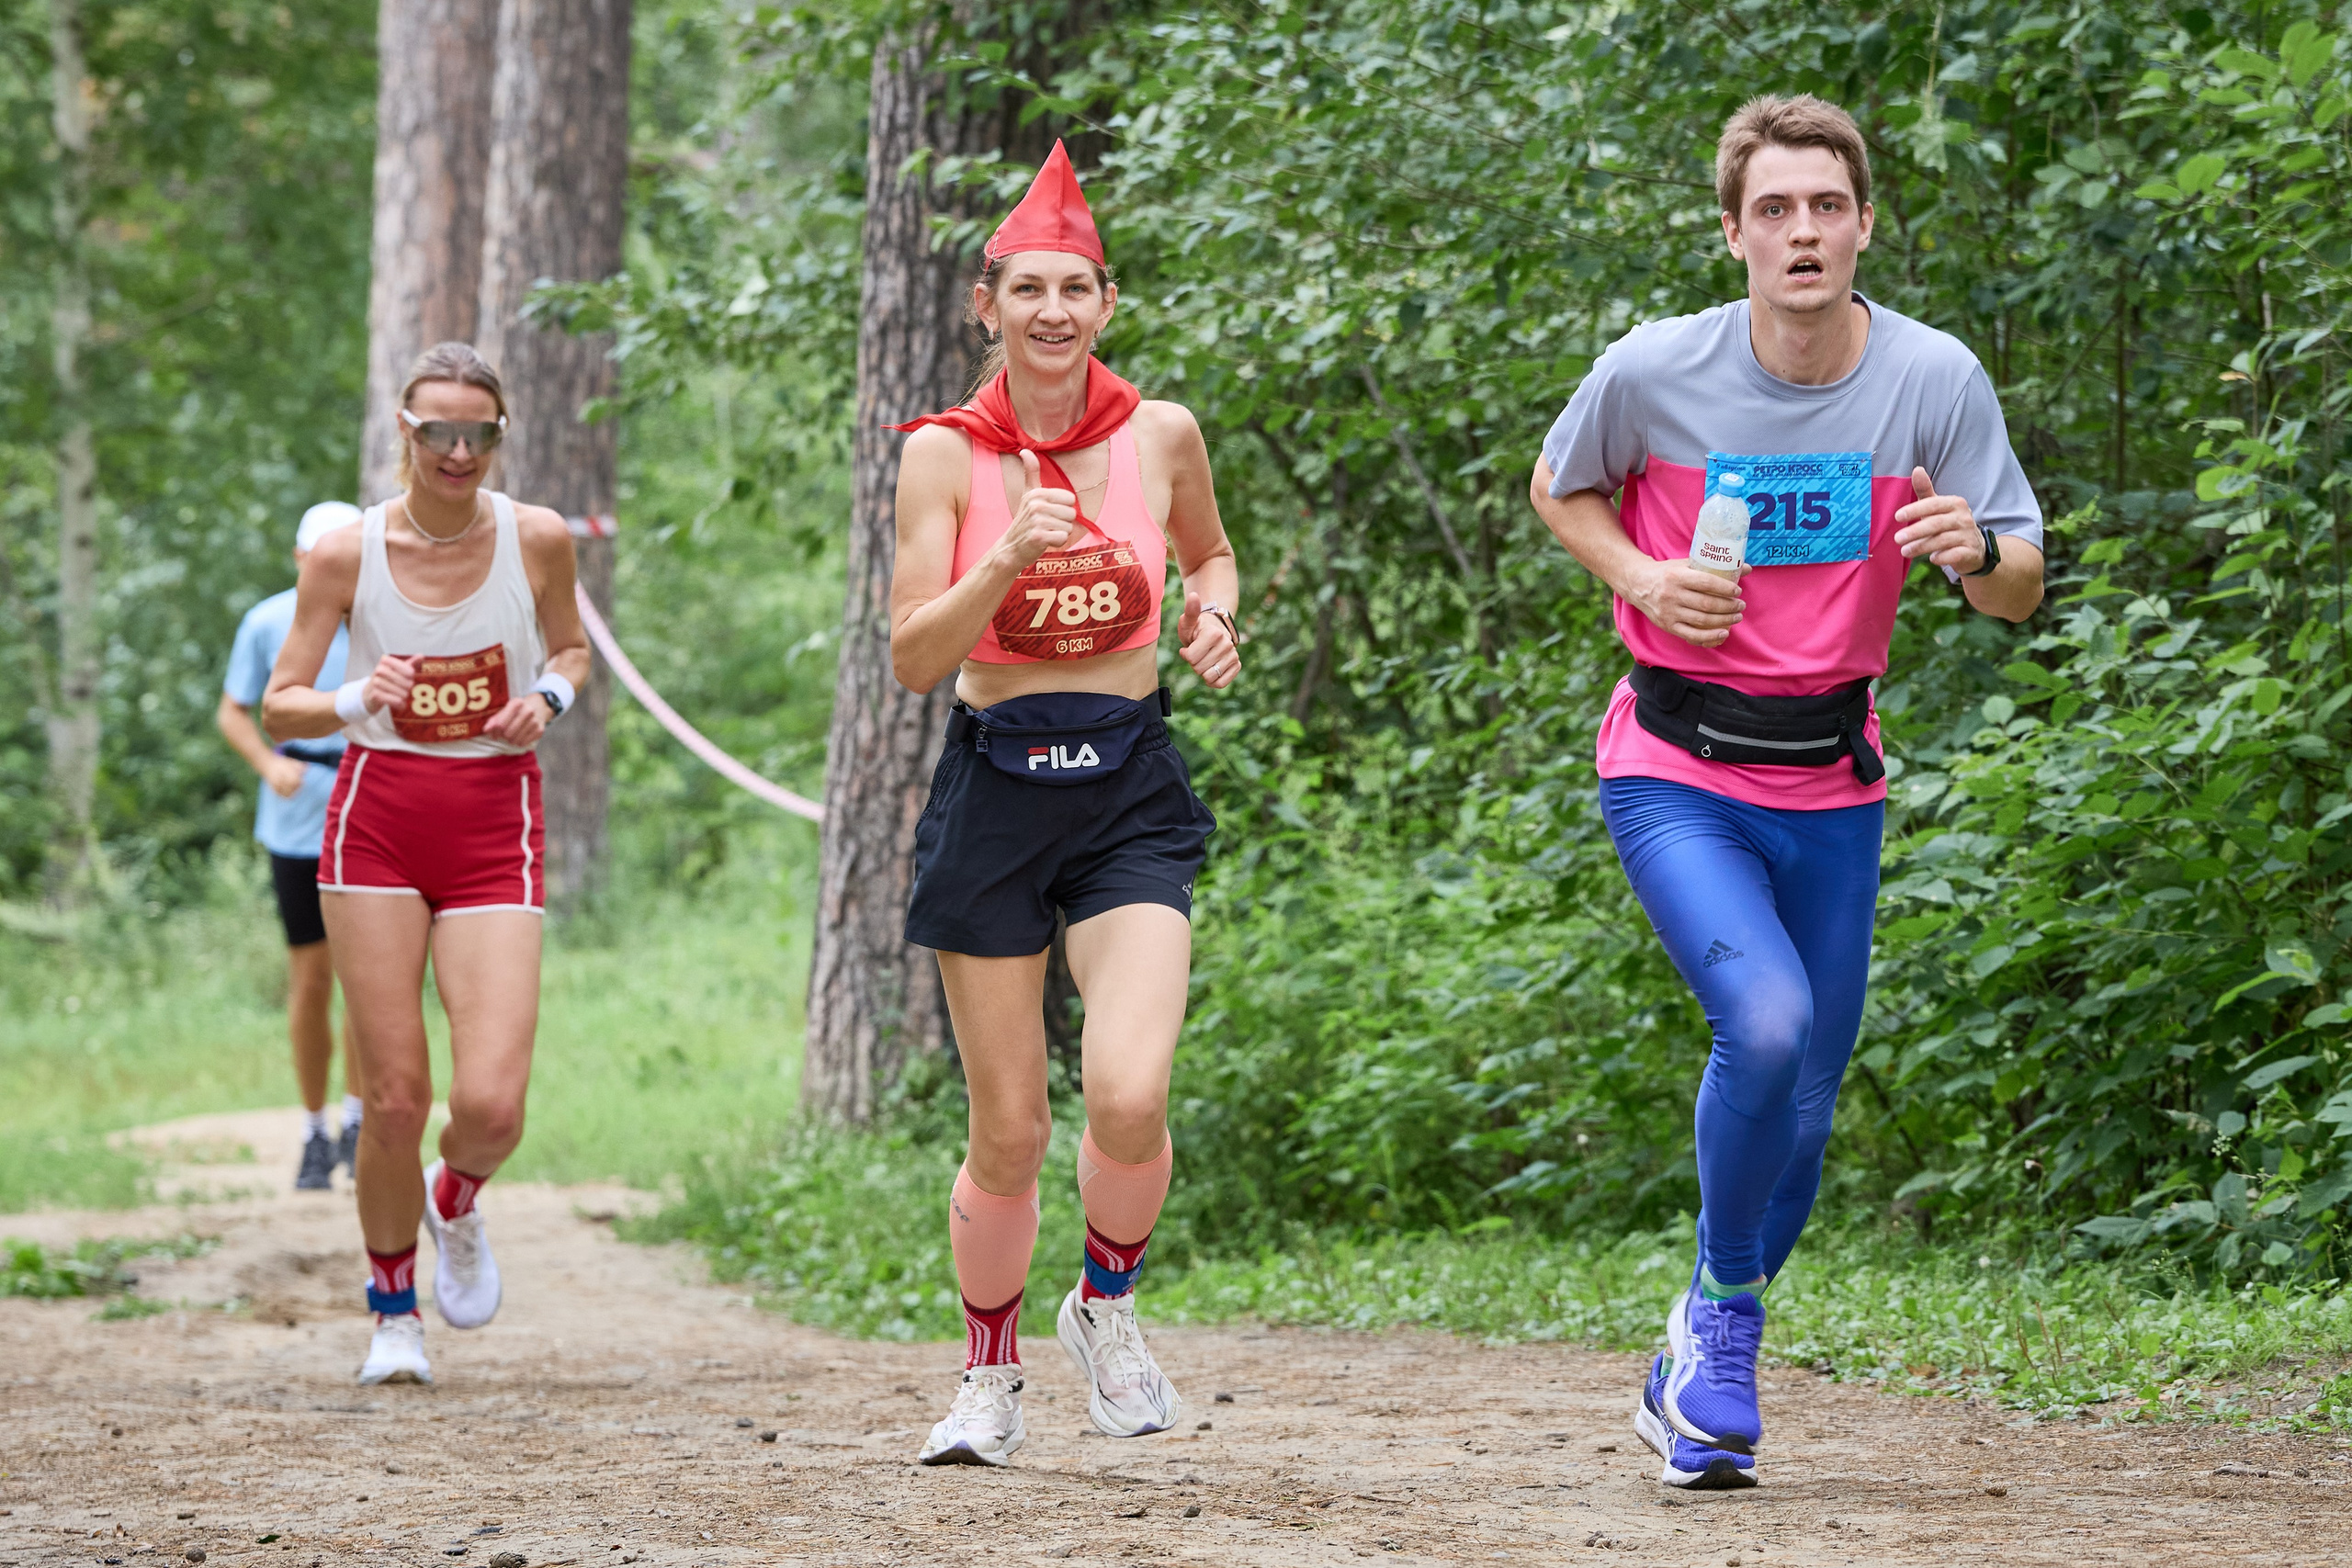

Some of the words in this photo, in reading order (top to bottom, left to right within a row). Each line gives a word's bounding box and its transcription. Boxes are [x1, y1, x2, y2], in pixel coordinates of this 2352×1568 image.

[1753, 465, 1786, 474] РЕТРО
[1788, 464, 1823, 473] КРОСС
[1746, 491, 1831, 530] 215
[1767, 545, 1782, 558] 12
[1035, 560, 1069, 571] РЕТРО
[1069, 554, 1102, 569] КРОСС
[1025, 581, 1121, 628] 788
[1057, 640, 1068, 653] 6
[411, 676, 492, 716] 805
[1028, 743, 1101, 771] FILA
[1703, 950, 1744, 968] adidas
